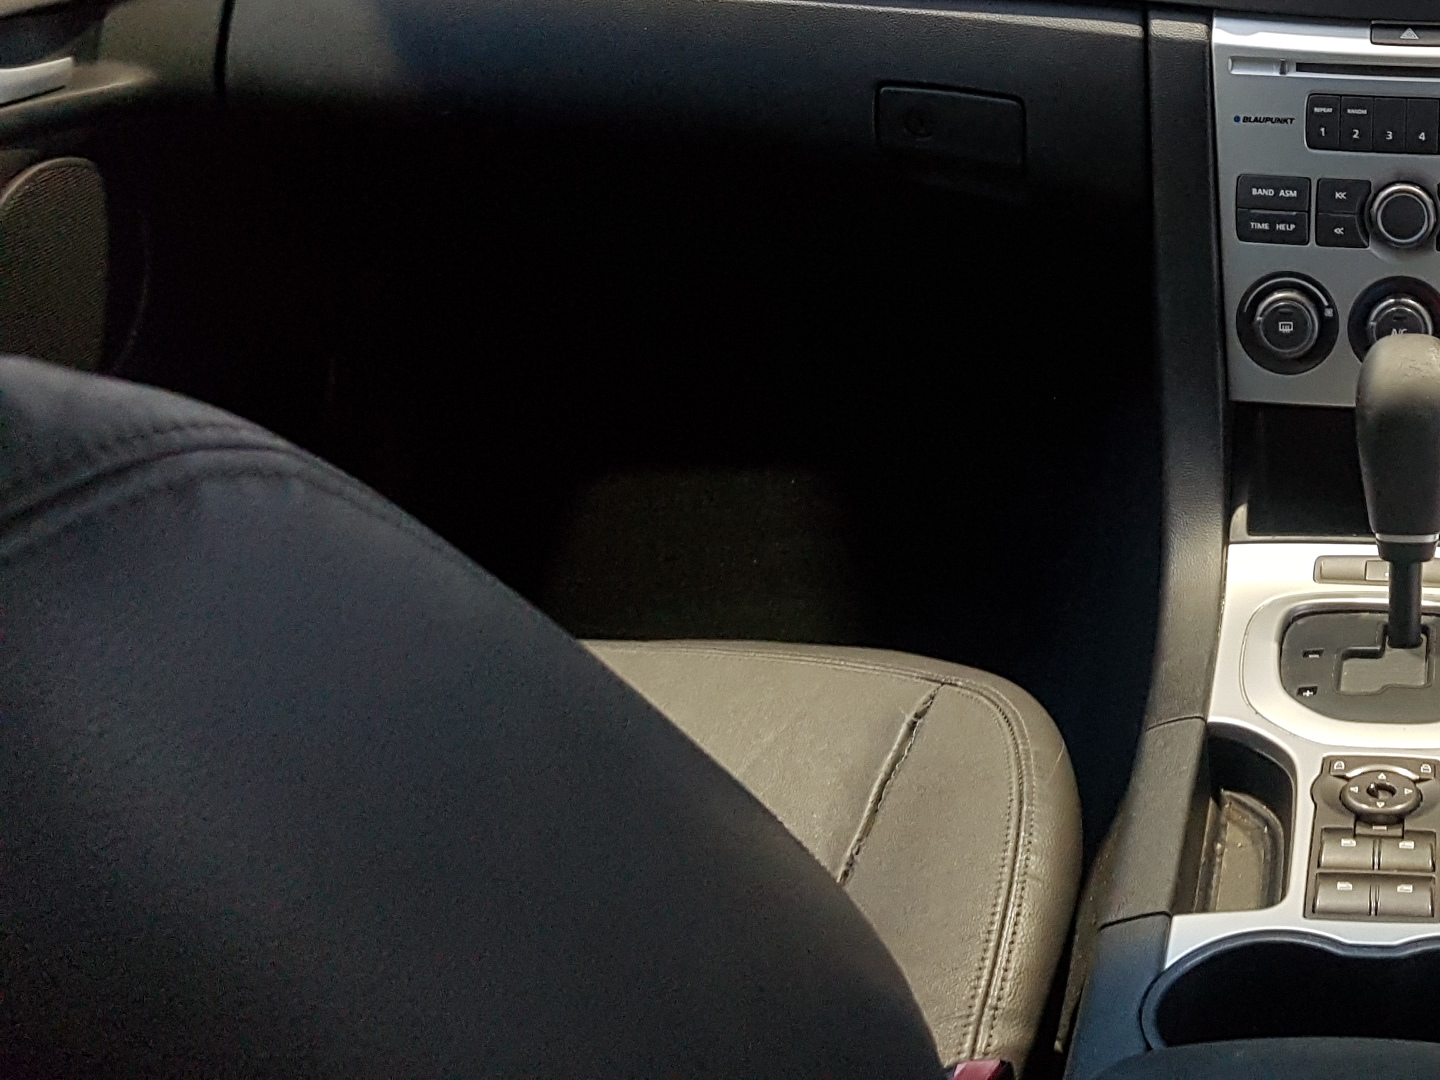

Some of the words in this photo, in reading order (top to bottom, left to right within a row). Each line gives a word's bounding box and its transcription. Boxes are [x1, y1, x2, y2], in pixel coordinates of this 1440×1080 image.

[1242, 116, 1296, 125] BLAUPUNKT
[1319, 127, 1326, 136] 1
[1352, 129, 1360, 138] 2
[1385, 131, 1393, 140] 3
[1418, 132, 1426, 141] 4
[1251, 187, 1275, 196] BAND
[1279, 189, 1298, 198] ASM
[1250, 222, 1270, 230] TIME
[1275, 223, 1296, 231] HELP
